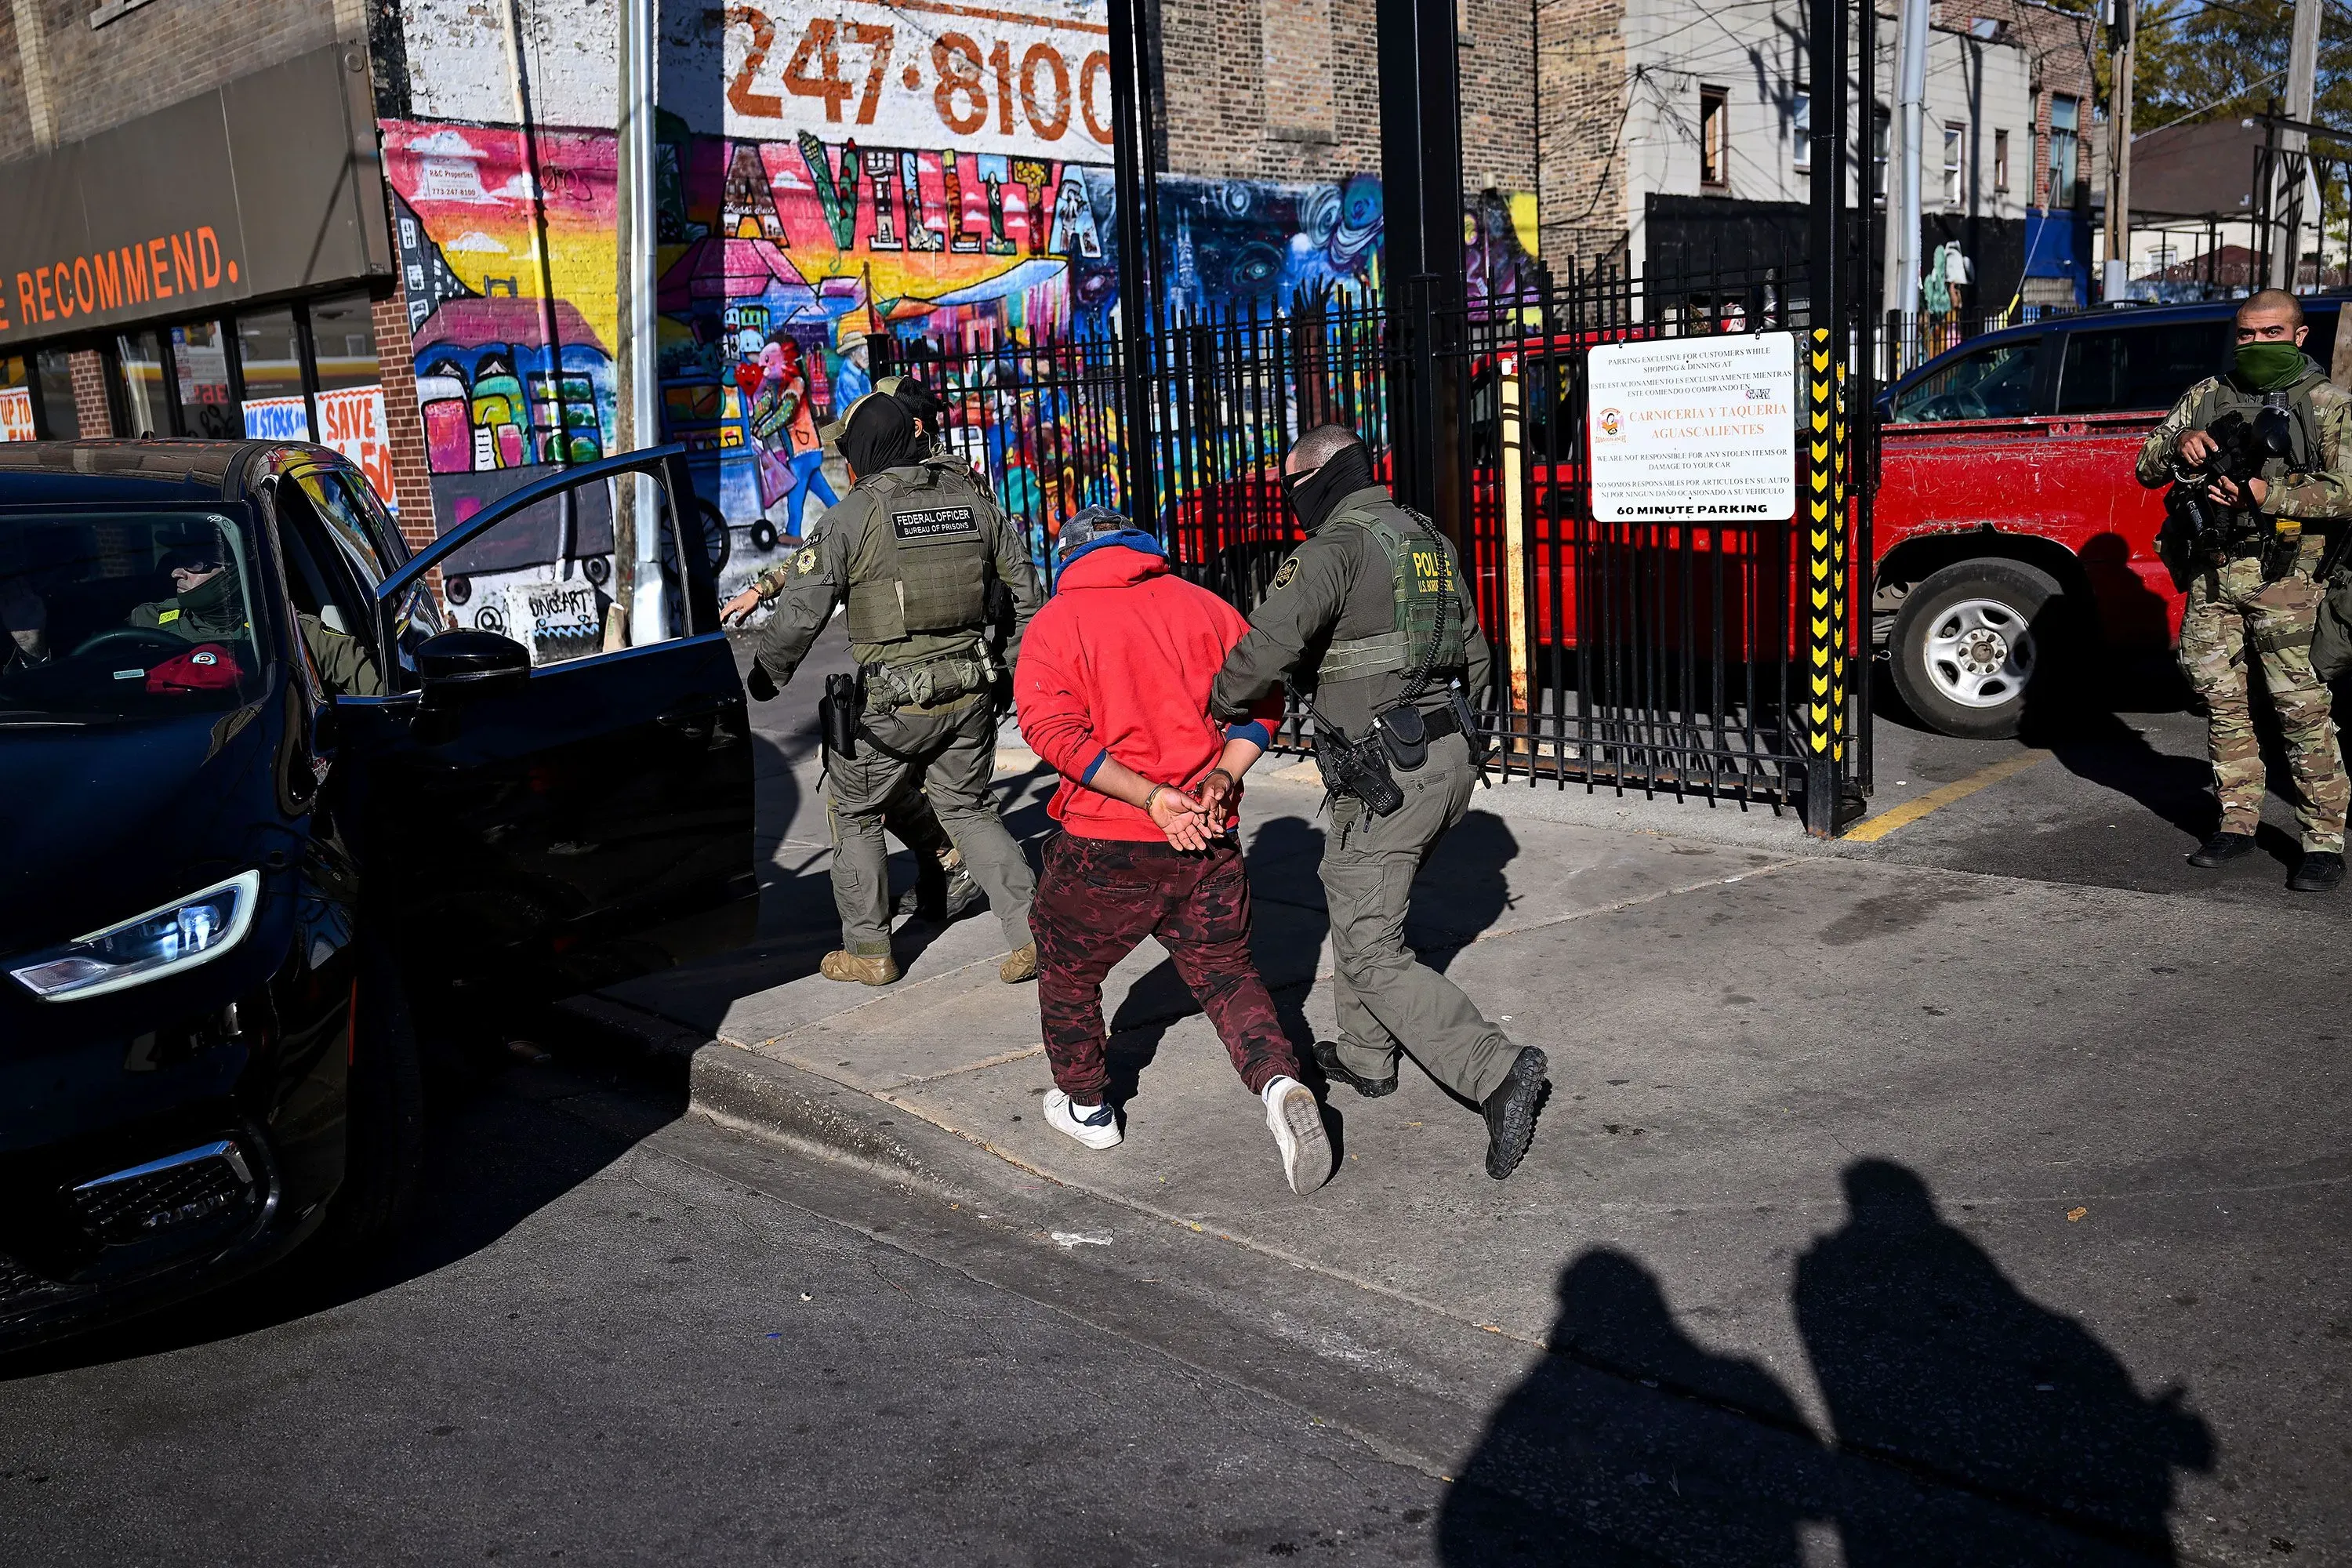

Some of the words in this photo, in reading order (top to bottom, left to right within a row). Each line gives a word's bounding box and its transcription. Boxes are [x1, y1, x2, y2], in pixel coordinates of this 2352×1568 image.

[445, 169, 474, 179] Properties
[797, 129, 1102, 258] VILLITA
[17, 224, 239, 326] RECOMMEND.
[1699, 349, 1744, 359] CUSTOMERS
[1643, 364, 1679, 373] SHOPPING
[1687, 361, 1721, 370] DINNING
[1608, 378, 1674, 388] ESTACIONAMIENTO
[1686, 373, 1751, 383] EXCLUSIVAMENTE
[1753, 370, 1792, 379] MIENTRAS
[1692, 384, 1739, 393] COMPRANDO
[0, 398, 14, 426] UP
[16, 397, 31, 424] TO
[1629, 408, 1704, 422] CARNICERIA
[1709, 408, 1717, 417] Y
[1719, 405, 1787, 417] TAQUERIA
[260, 405, 295, 438] STOCK
[325, 398, 376, 442] SAVE
[1652, 423, 1764, 439] AGUASCALIENTES
[897, 514, 936, 525] FEDERAL
[936, 510, 970, 522] OFFICER
[1617, 506, 1634, 515] 60
[1637, 506, 1693, 514] MINUTE
[1697, 505, 1768, 514] PARKING
[904, 525, 930, 535] BUREAU
[942, 522, 969, 531] PRISONS
[1413, 552, 1452, 577] POLIE
